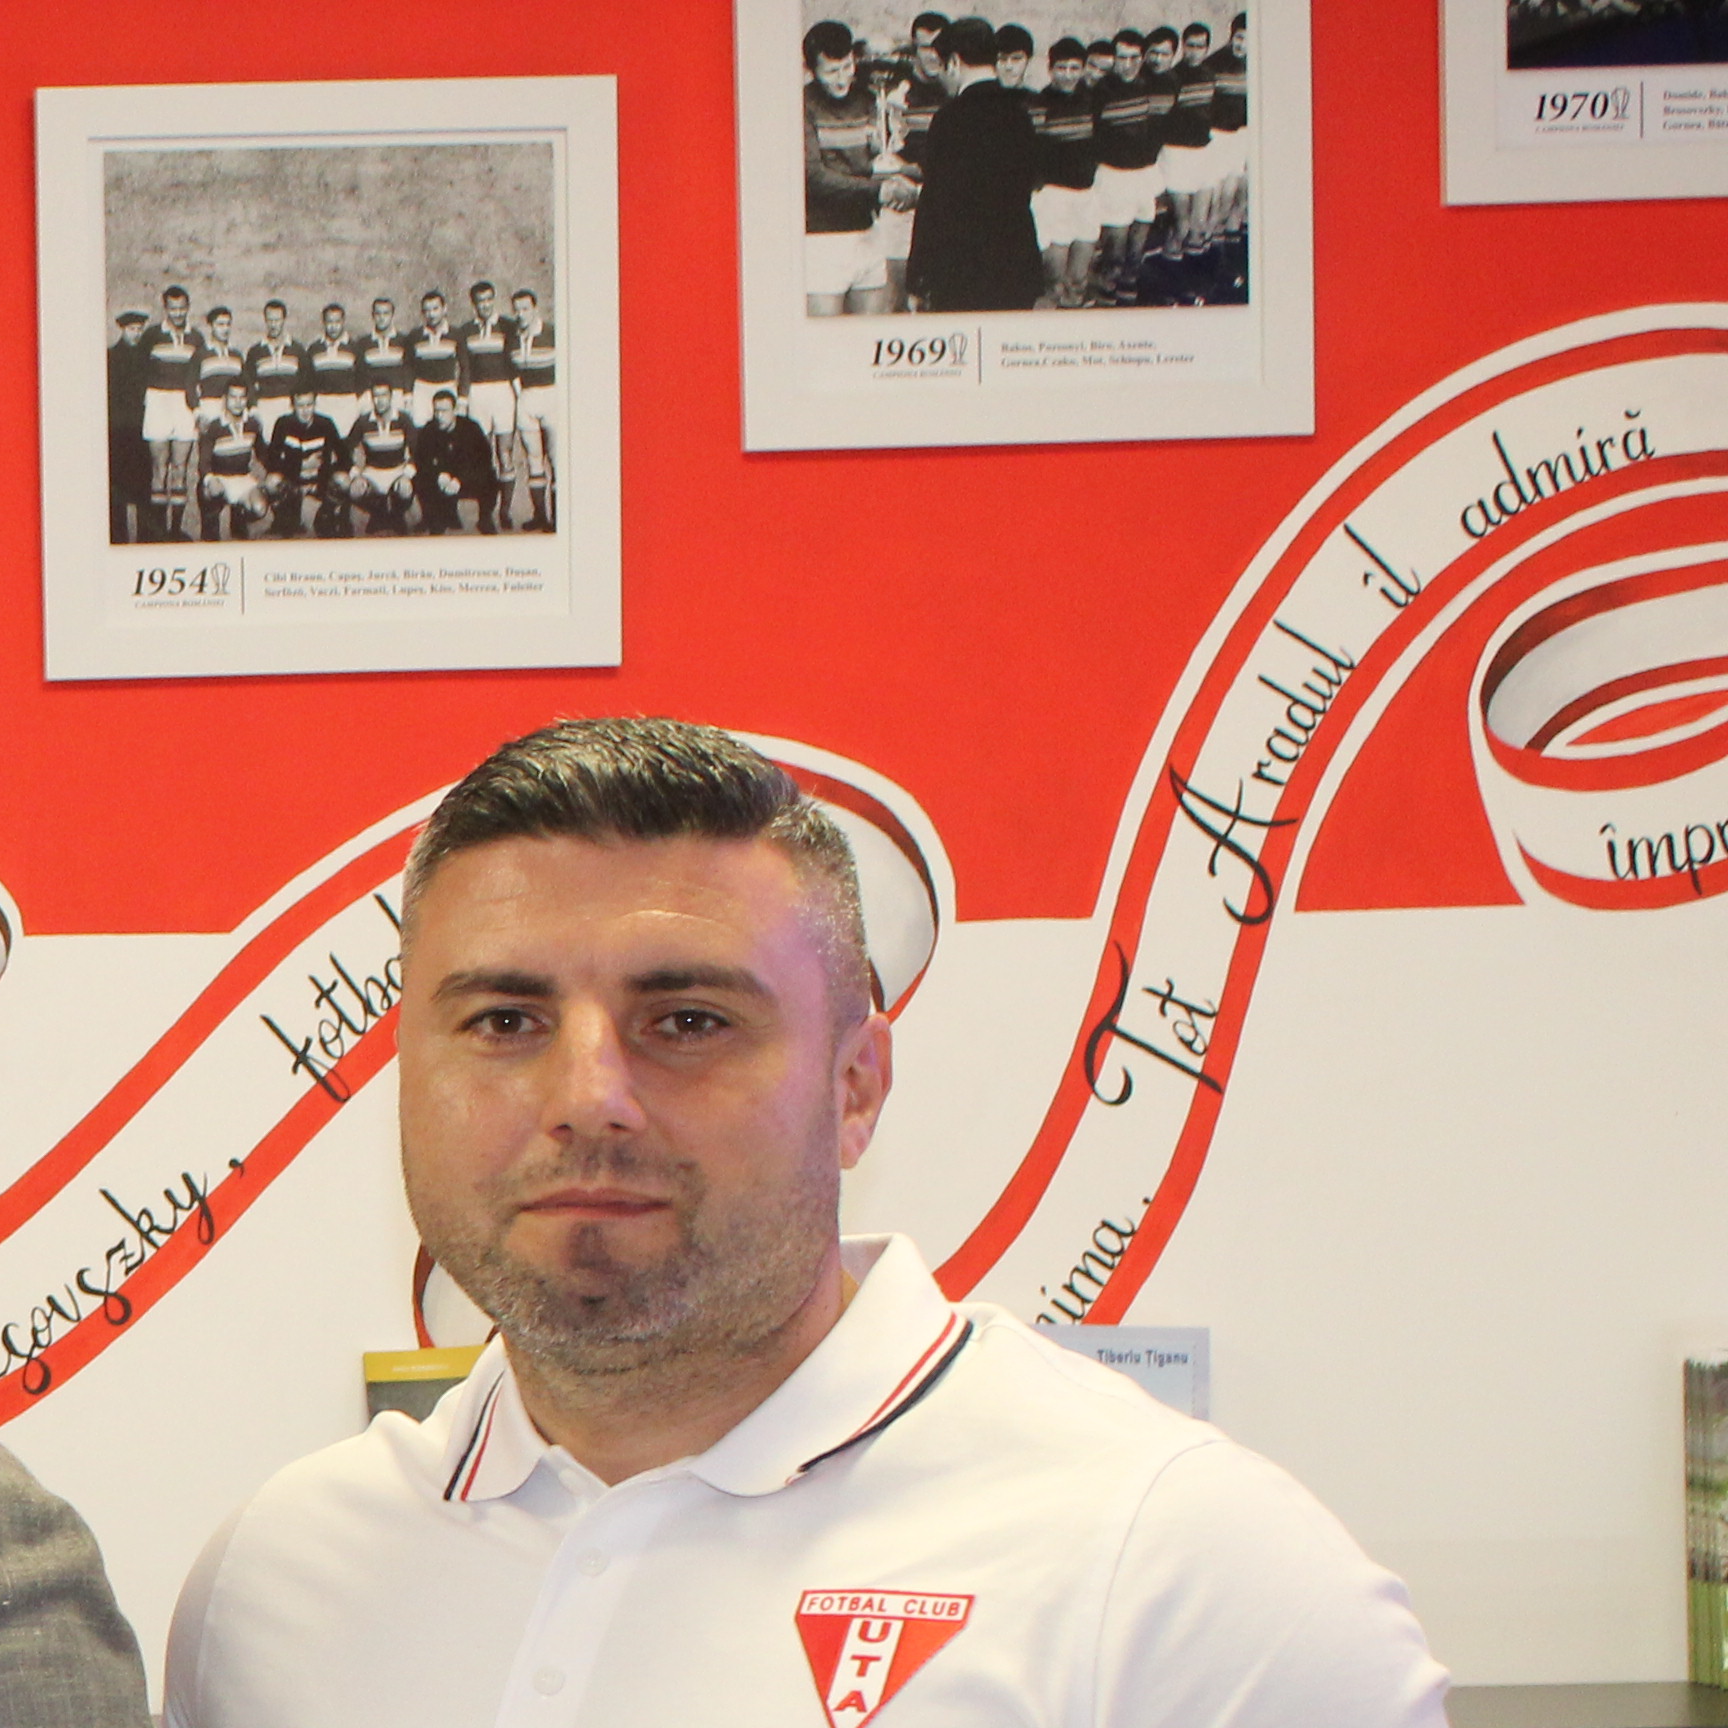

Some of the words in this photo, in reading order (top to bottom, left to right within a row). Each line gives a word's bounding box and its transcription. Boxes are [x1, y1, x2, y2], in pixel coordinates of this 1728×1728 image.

[1534, 92, 1609, 121] 1970
[871, 338, 948, 366] 1969
[132, 566, 208, 596] 1954
[1083, 941, 1224, 1106] Tot
[1168, 616, 1356, 928] Aradul
[1458, 410, 1656, 540] admiră
[806, 1596, 888, 1613] FOTBAL
[903, 1598, 962, 1617] CLUB
